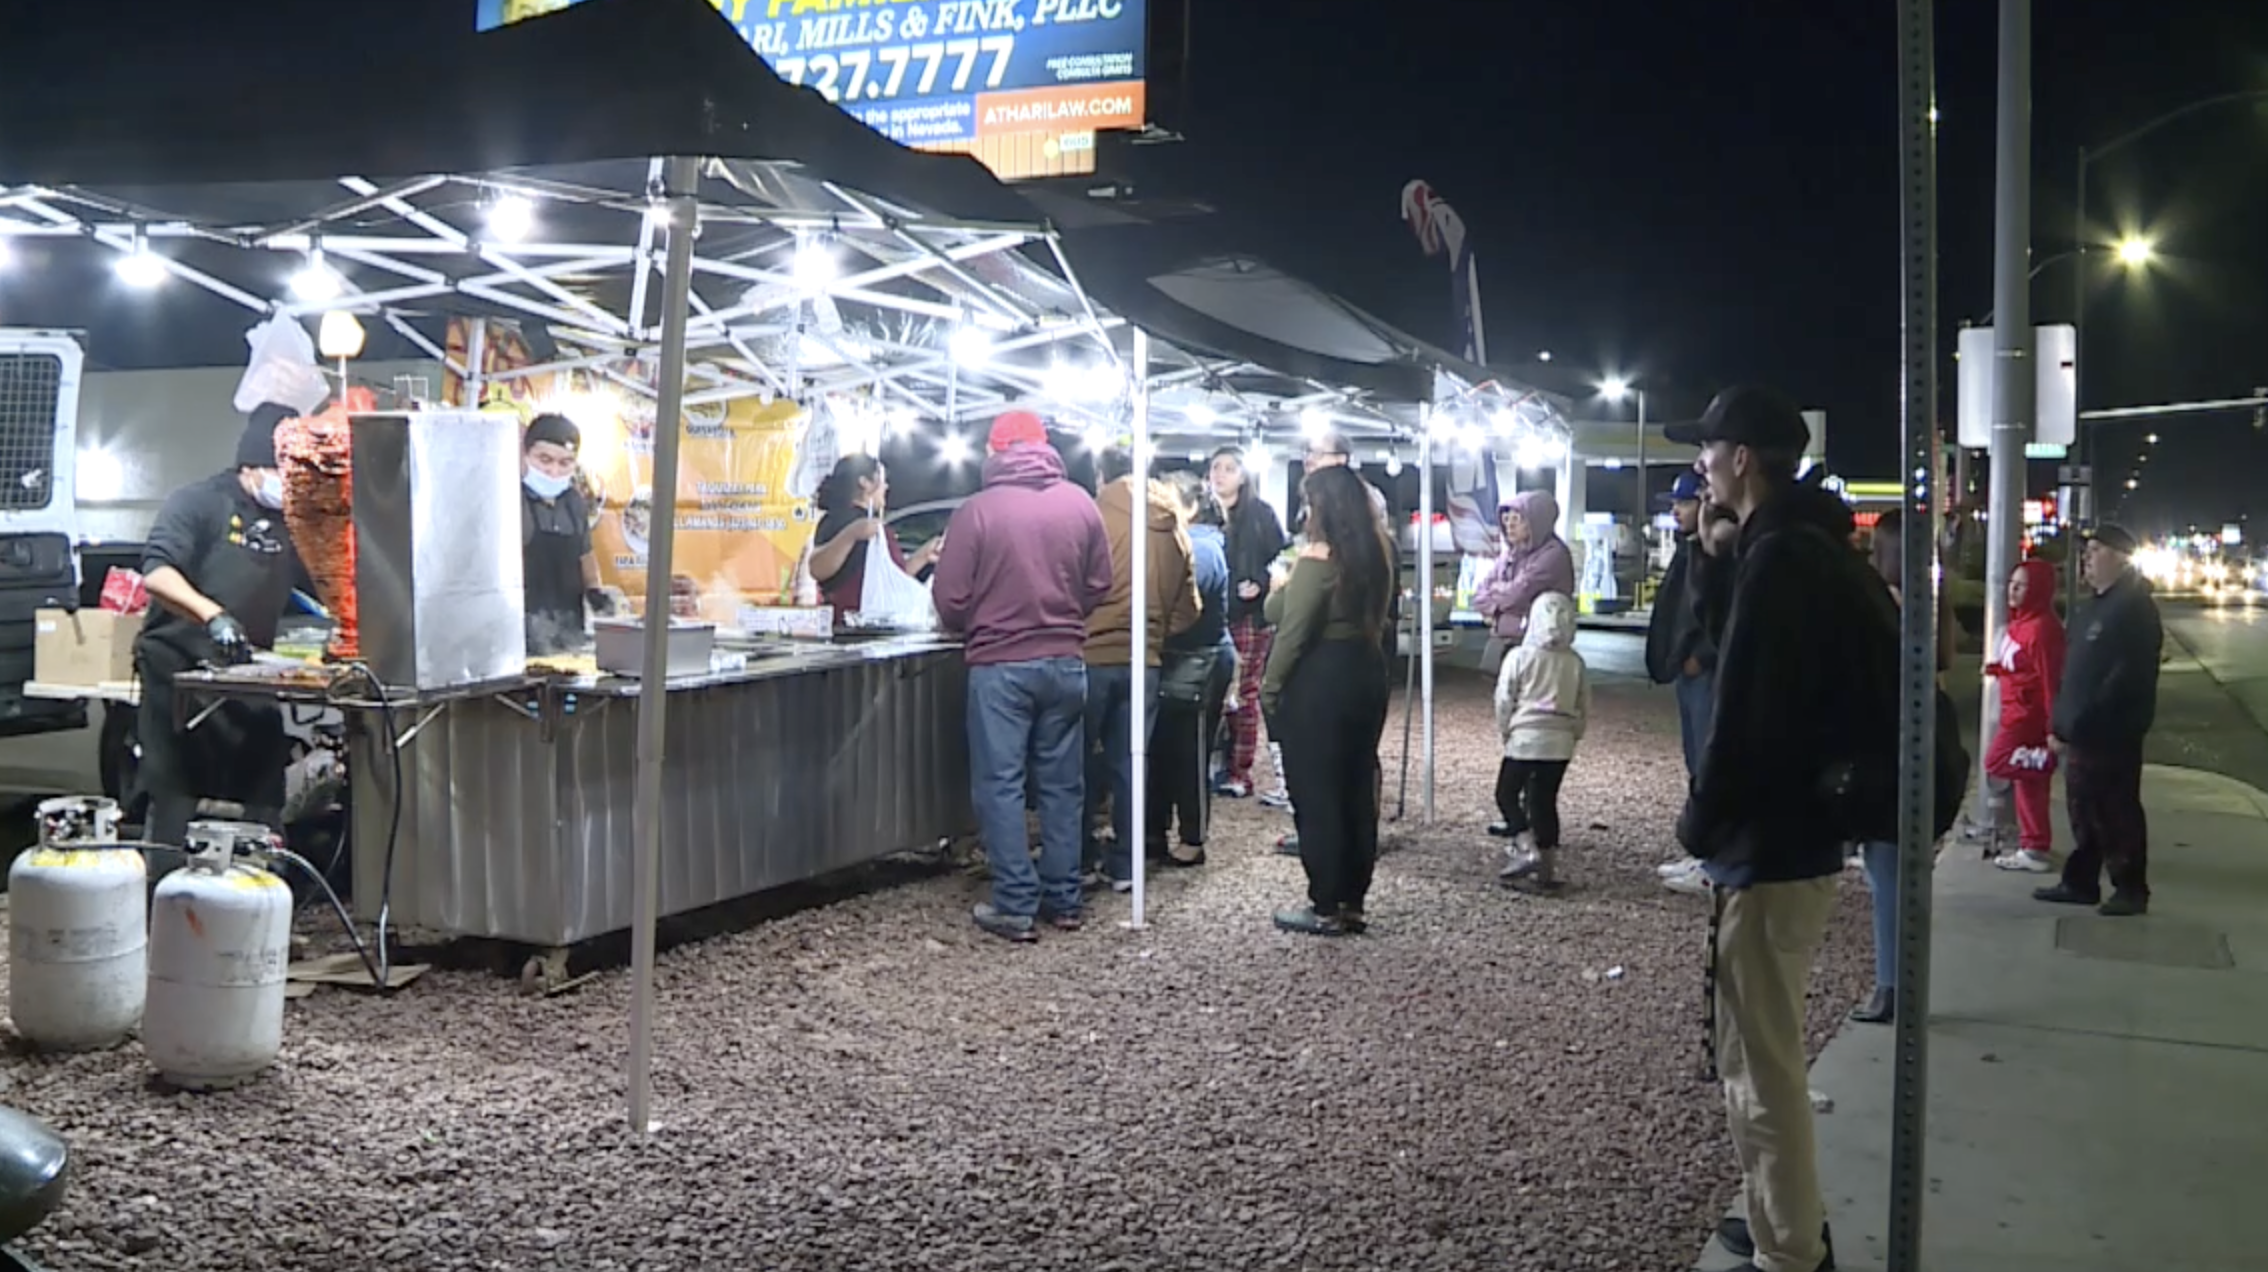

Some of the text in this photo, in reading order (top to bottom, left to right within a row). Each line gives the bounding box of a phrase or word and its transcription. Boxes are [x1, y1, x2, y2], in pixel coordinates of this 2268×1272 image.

[740, 22, 789, 56] RI,
[795, 8, 895, 51] MILLS
[899, 5, 929, 40] &
[933, 0, 1025, 34] FINK,
[1031, 0, 1122, 26] PLLC
[865, 107, 888, 127] the
[891, 101, 971, 125] appropriate
[984, 96, 1133, 126] ATHARILAW.COM
